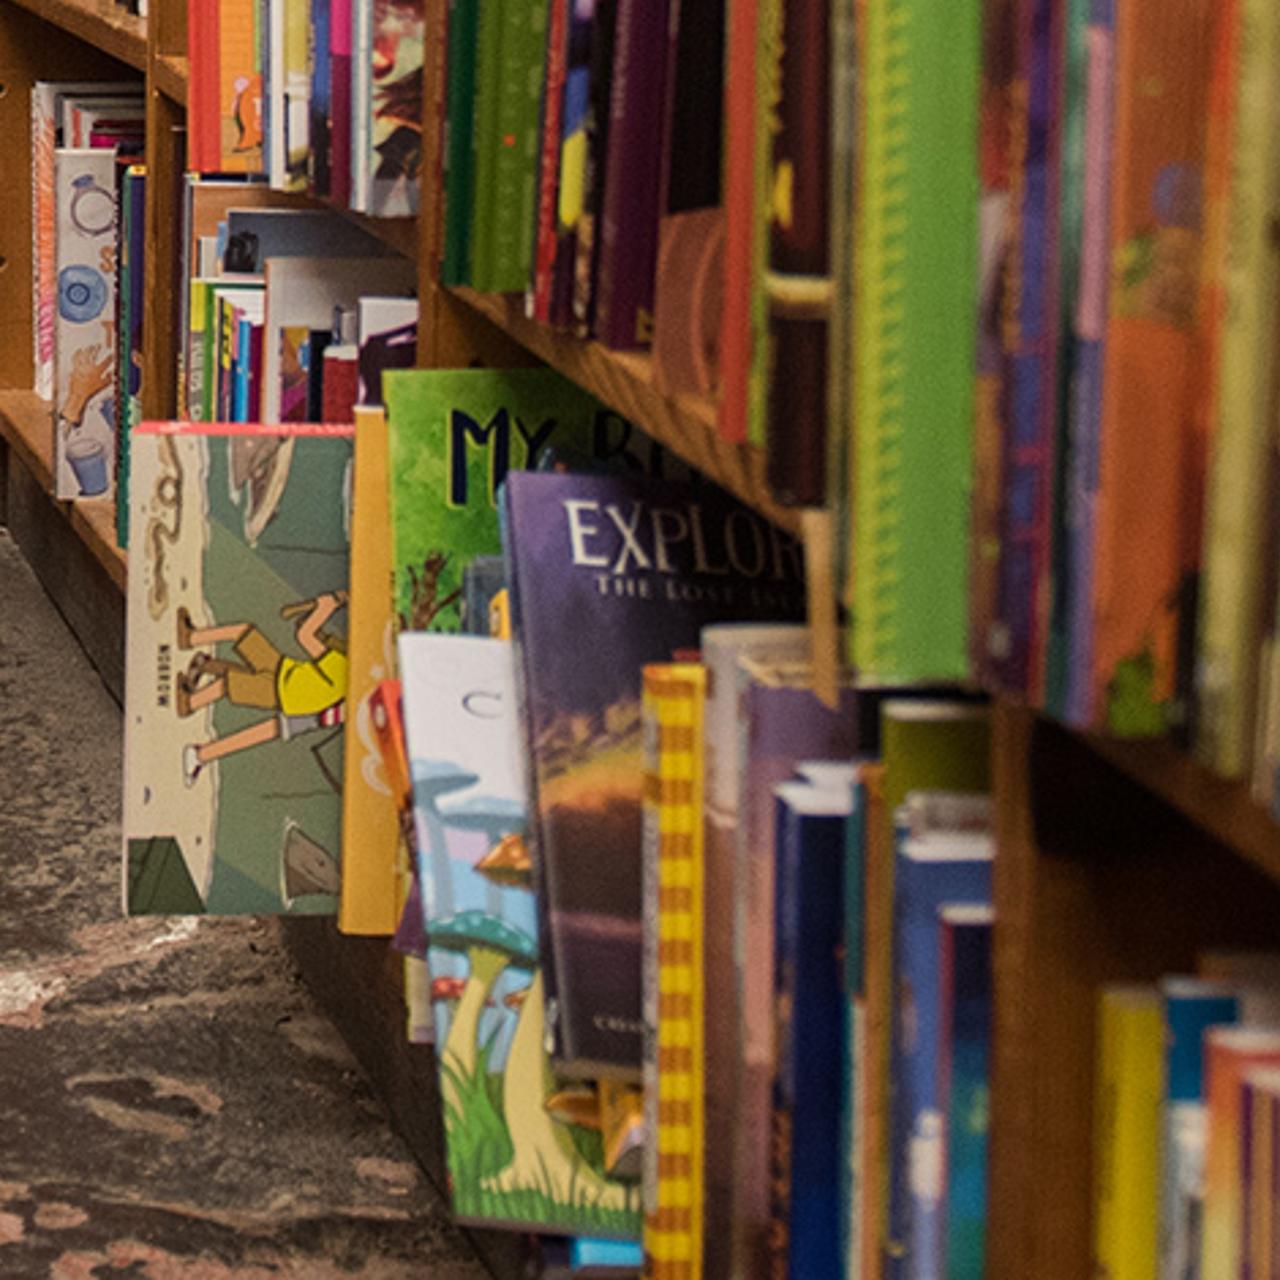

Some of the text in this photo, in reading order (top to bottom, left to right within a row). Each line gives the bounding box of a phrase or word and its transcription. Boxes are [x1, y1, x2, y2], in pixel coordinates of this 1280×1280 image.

[448, 407, 557, 507] MY
[596, 575, 733, 603] THE LOST
